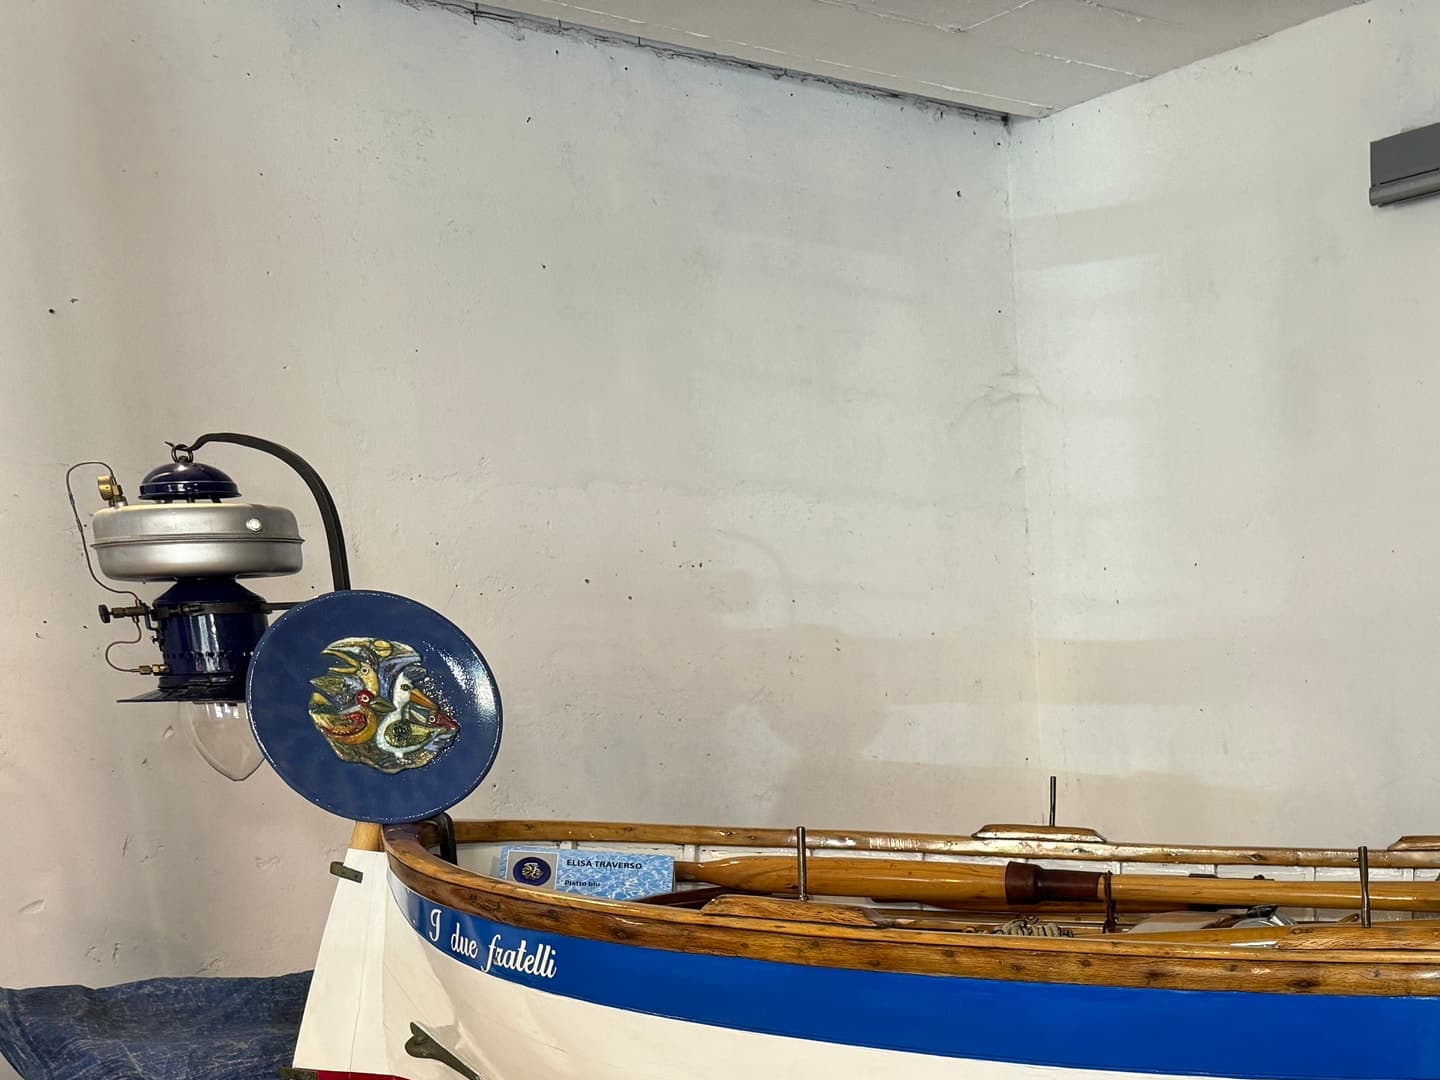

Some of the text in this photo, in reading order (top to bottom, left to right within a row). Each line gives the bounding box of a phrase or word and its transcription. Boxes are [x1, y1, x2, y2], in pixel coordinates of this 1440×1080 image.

[566, 859, 643, 870] ELISA TRAVERSO
[587, 880, 600, 888] blu
[450, 922, 479, 959] due
[480, 934, 557, 978] fratelli
